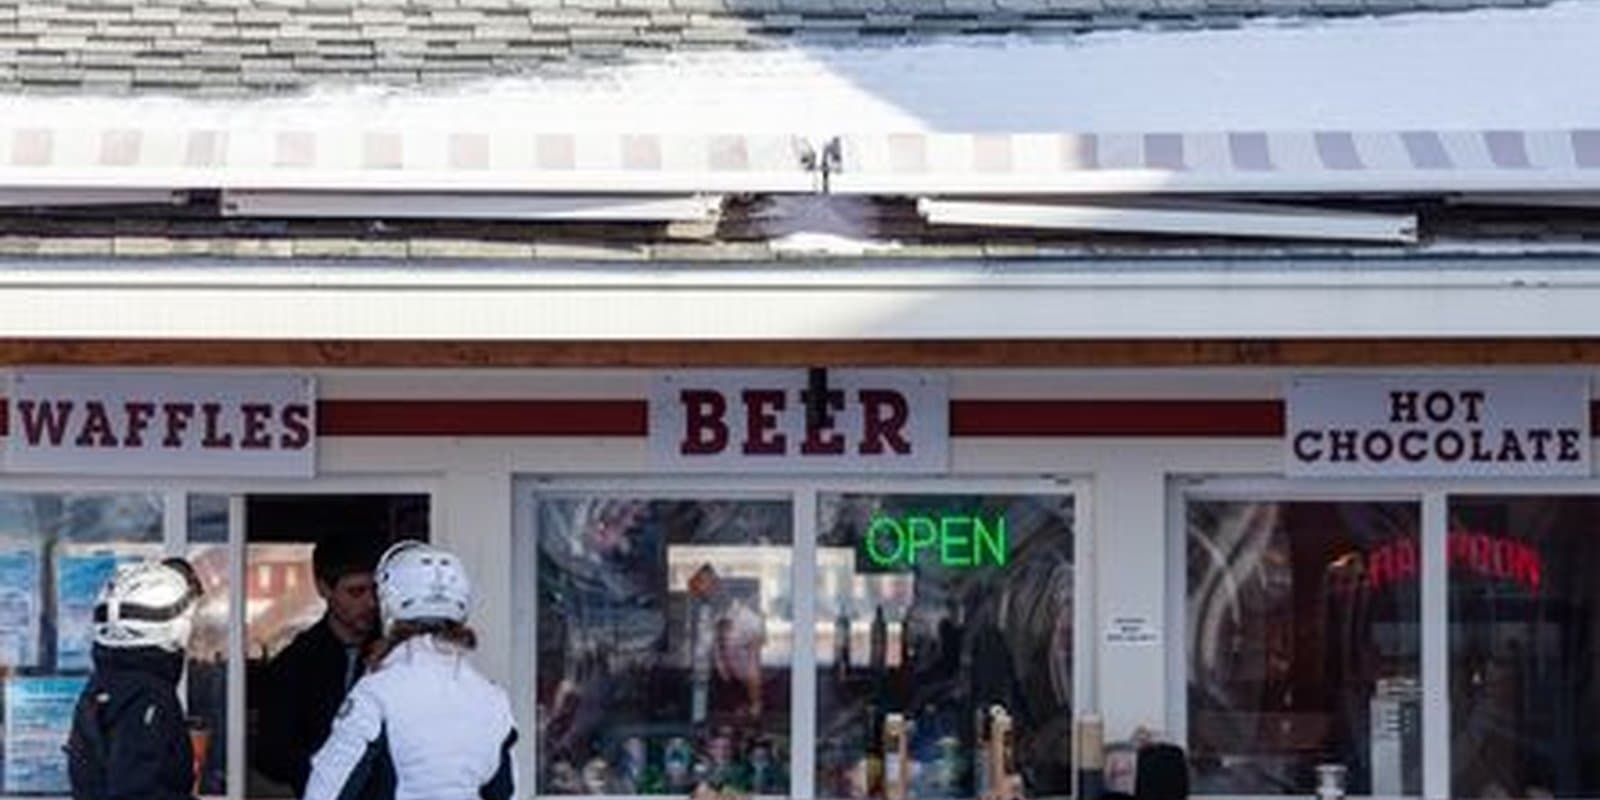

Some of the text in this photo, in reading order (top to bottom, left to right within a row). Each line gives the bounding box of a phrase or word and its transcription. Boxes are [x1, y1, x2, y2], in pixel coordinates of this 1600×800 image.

[18, 400, 311, 450] WAFFLES
[679, 388, 912, 457] BEER
[1389, 390, 1486, 425] HOT
[1293, 429, 1582, 463] CHOCOLATE
[865, 511, 1008, 569] OPEN
